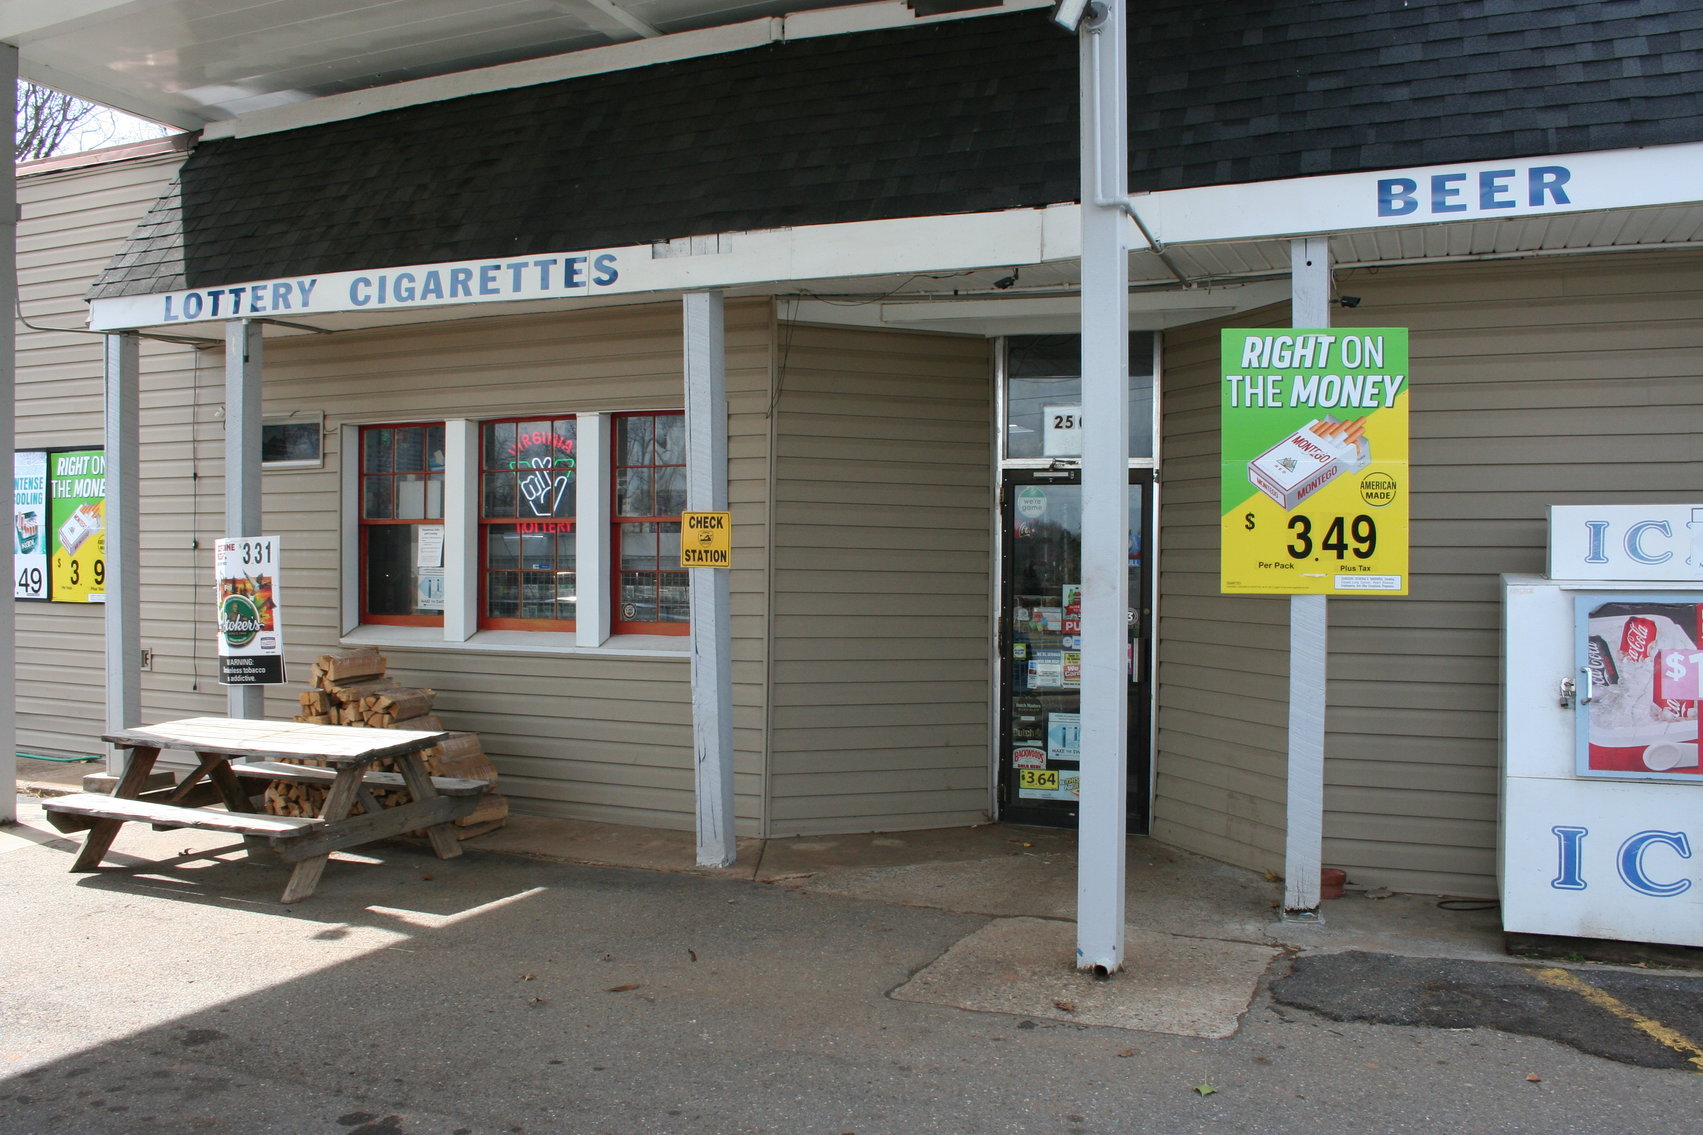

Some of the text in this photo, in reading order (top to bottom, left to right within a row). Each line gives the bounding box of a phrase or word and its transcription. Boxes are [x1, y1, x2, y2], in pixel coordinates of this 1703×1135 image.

[1377, 166, 1571, 217] BEER
[164, 253, 619, 321] LOTTERY CIGARETTES
[1241, 335, 1384, 369] RIGHT ON
[1226, 374, 1405, 409] THE MONEY
[1054, 415, 1082, 429] 25
[1291, 435, 1331, 463] MONTEGO
[57, 456, 91, 476] RIGHT
[14, 477, 44, 490] NTENSE
[51, 478, 105, 498] THE MONE
[1297, 465, 1338, 500] MONTEGO
[1360, 480, 1397, 490] AMERICAN
[14, 492, 43, 505] OOLING
[1365, 491, 1391, 500] MADE
[689, 516, 723, 529] CHECK
[1245, 512, 1377, 562] $ 3.49
[1584, 520, 1692, 565] IC
[685, 549, 727, 562] STATION
[1274, 562, 1294, 570] Pack
[1013, 728, 1035, 737] Dutch
[1014, 749, 1044, 764] BACKWOODS
[1026, 771, 1056, 786] 3.64
